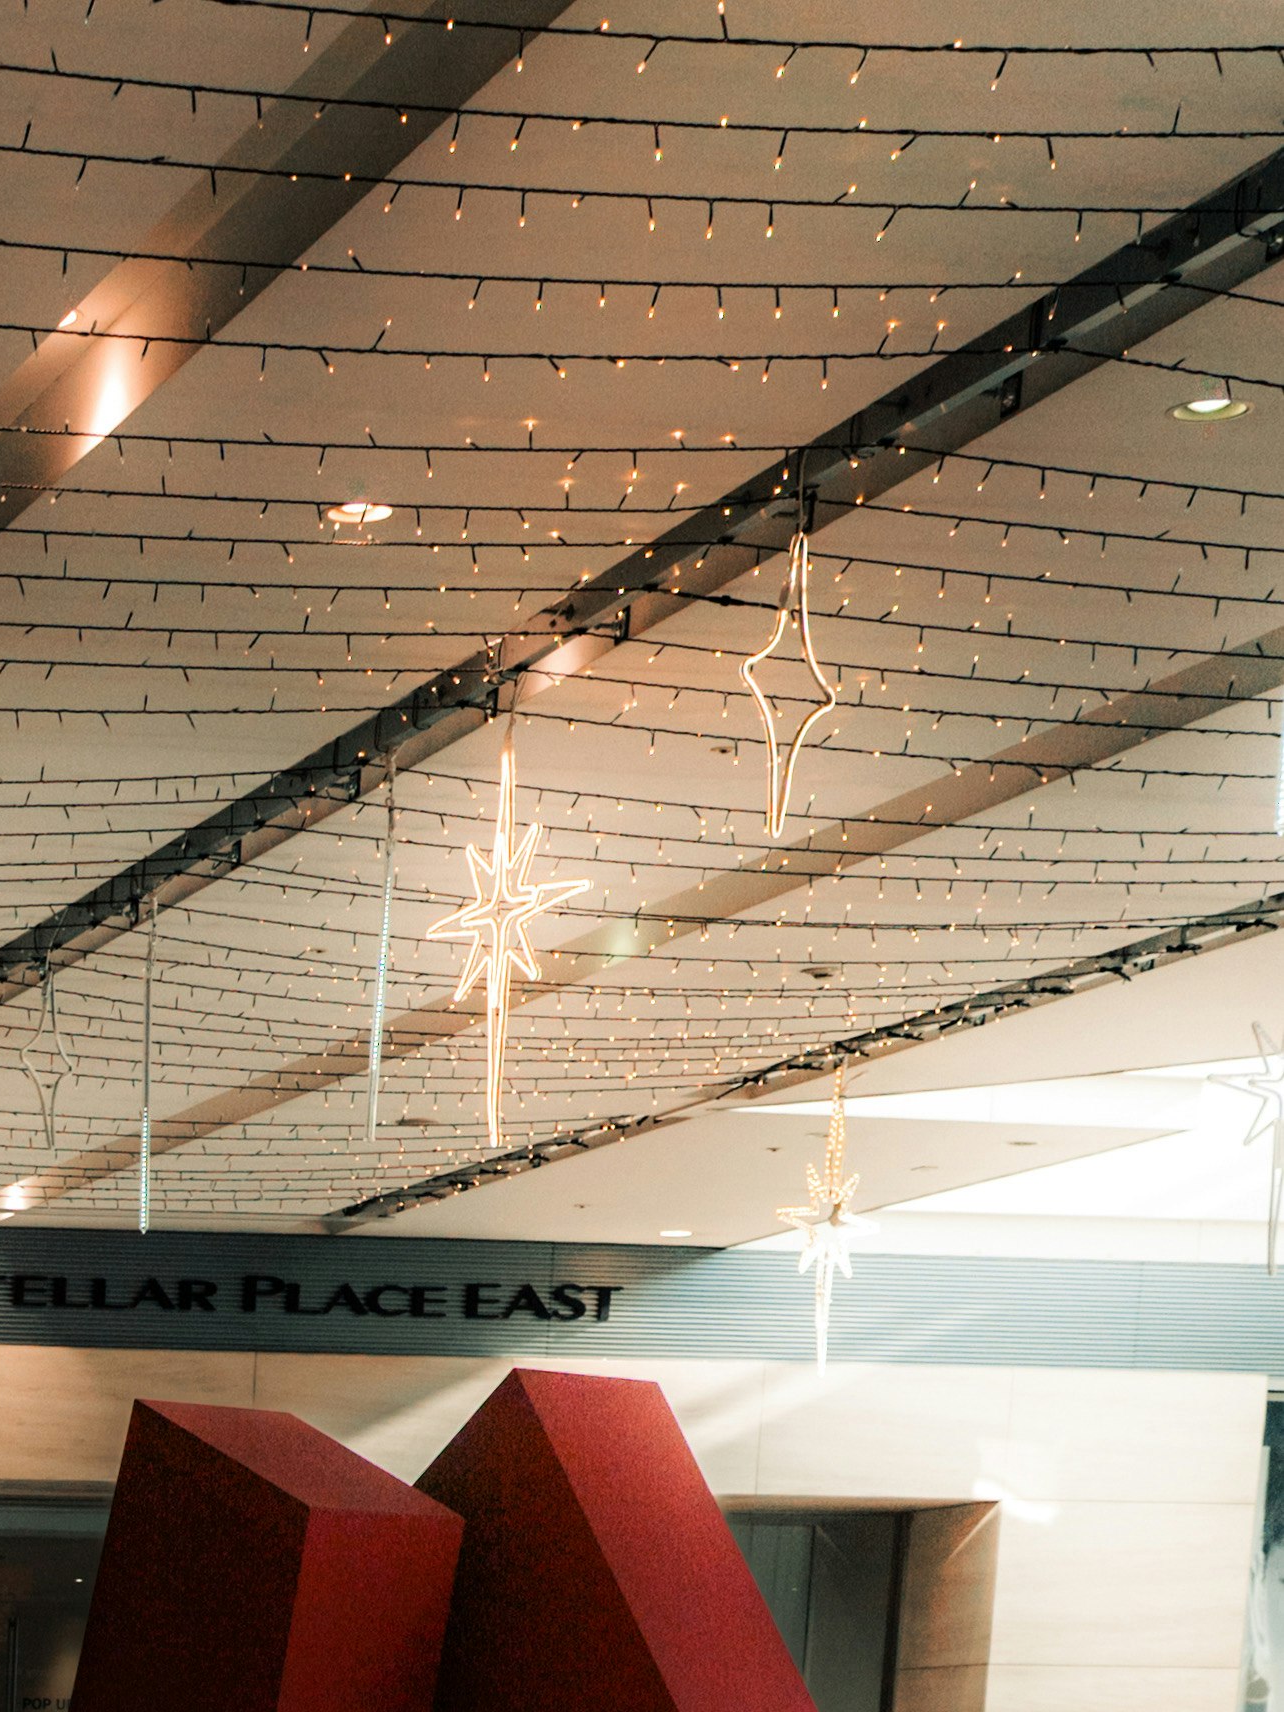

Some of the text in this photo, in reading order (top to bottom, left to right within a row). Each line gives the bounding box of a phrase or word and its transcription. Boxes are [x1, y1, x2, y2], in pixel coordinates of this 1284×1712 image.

[241, 1274, 448, 1317] PLACE
[464, 1282, 625, 1323] EAST
[22, 1698, 51, 1710] POP
